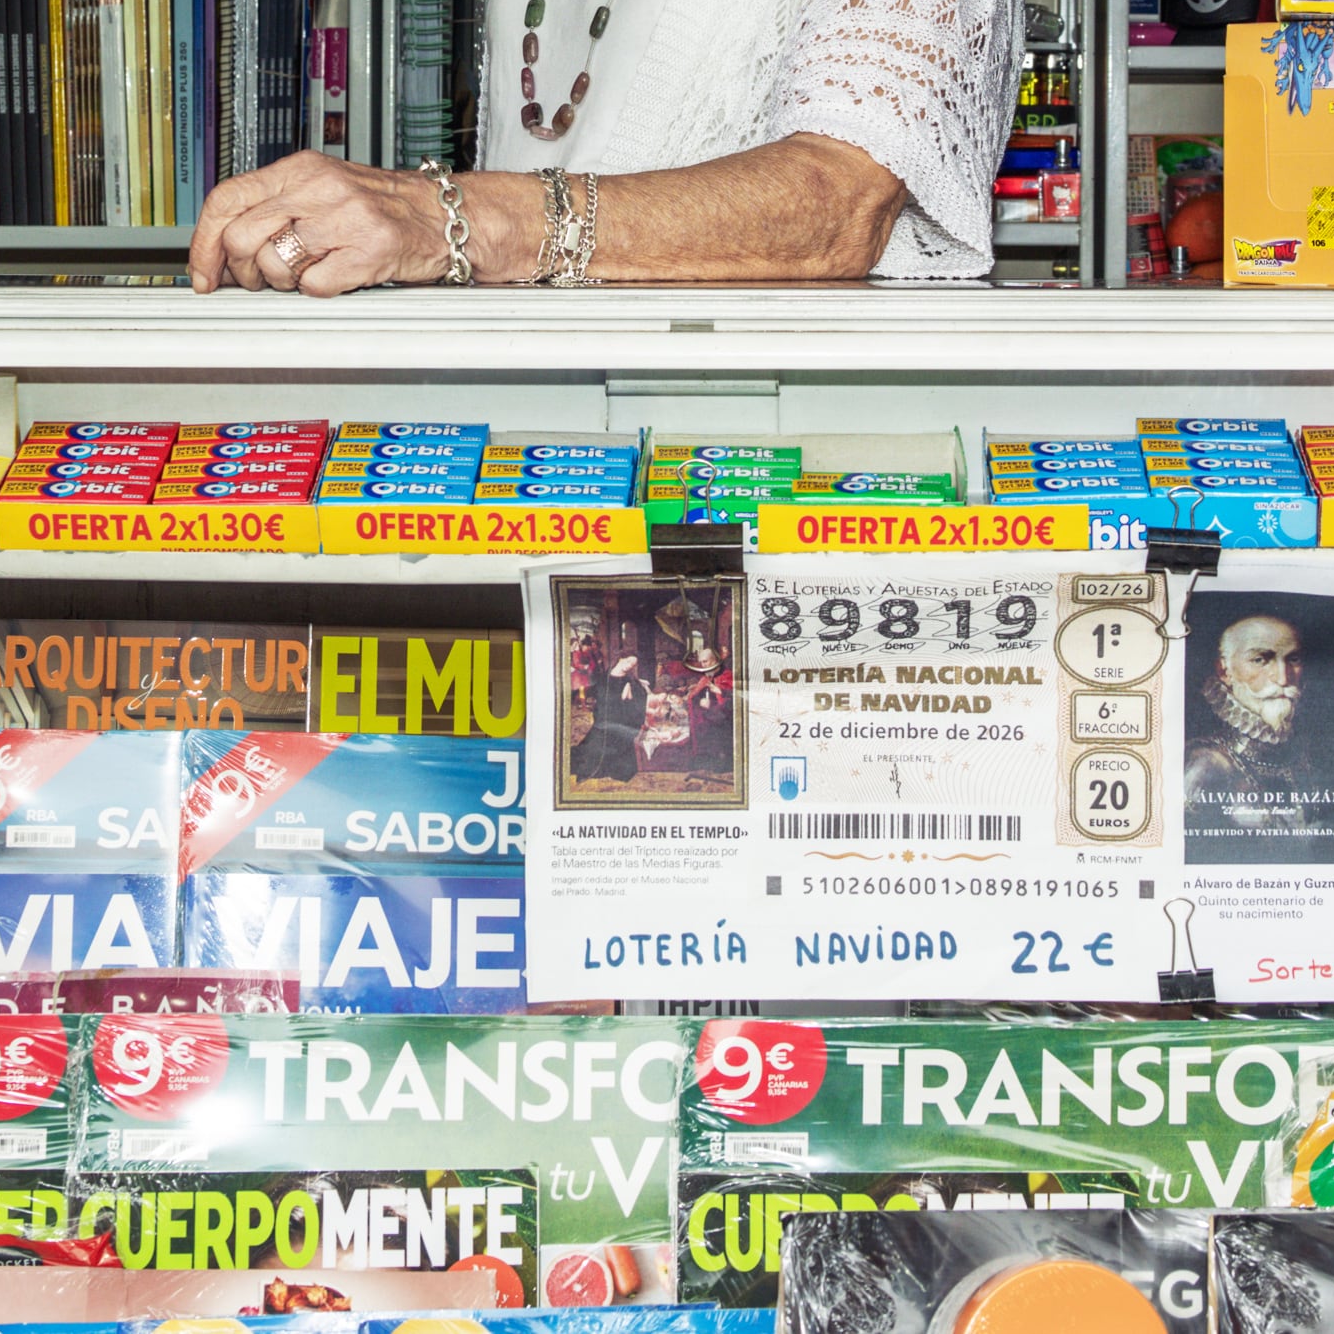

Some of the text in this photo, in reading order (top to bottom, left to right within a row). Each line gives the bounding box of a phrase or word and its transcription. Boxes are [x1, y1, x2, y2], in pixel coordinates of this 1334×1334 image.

[28, 513, 285, 544] OFERTA 2x1.30€
[797, 515, 1055, 546] OFERTA 2x1.30€
[1081, 582, 1144, 597] 102/26
[760, 596, 1036, 644] 89819
[762, 664, 1043, 685] LOTERÍA NACIONAL
[1094, 667, 1124, 678] SERIE
[814, 693, 992, 714] DE NAVIDAD
[779, 722, 1024, 742] 22 de diciembre de 2026
[1078, 720, 1140, 735] FRACCIÓN
[1089, 760, 1130, 772] PRECIO
[1089, 780, 1129, 810] 20
[1089, 819, 1131, 828] EUROS
[584, 921, 1115, 974] LOTERÍA NAVIDAD 22 €
